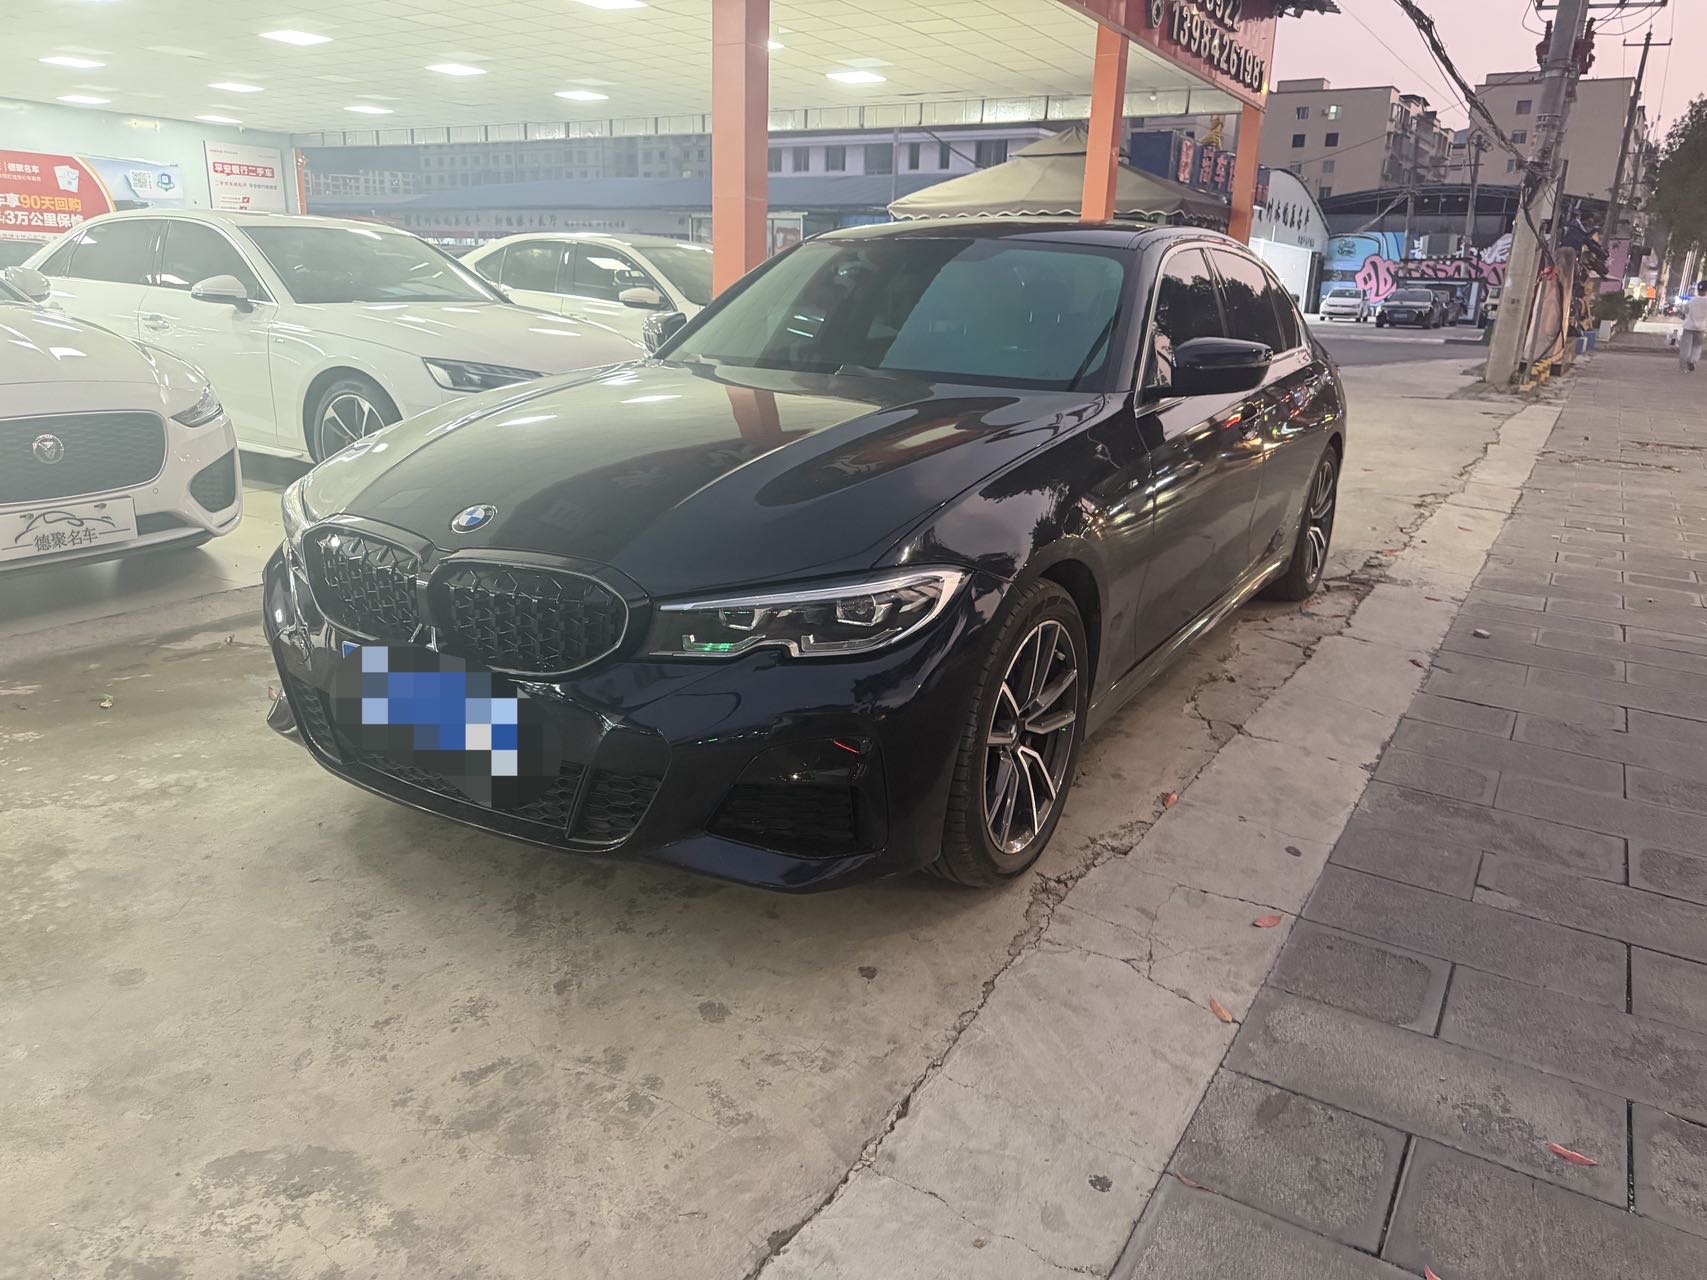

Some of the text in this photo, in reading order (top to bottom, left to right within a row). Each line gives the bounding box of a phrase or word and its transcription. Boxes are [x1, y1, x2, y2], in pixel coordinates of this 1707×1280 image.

[214, 163, 273, 177] 平安银行二手车
[33, 527, 98, 551] 德聚名车
